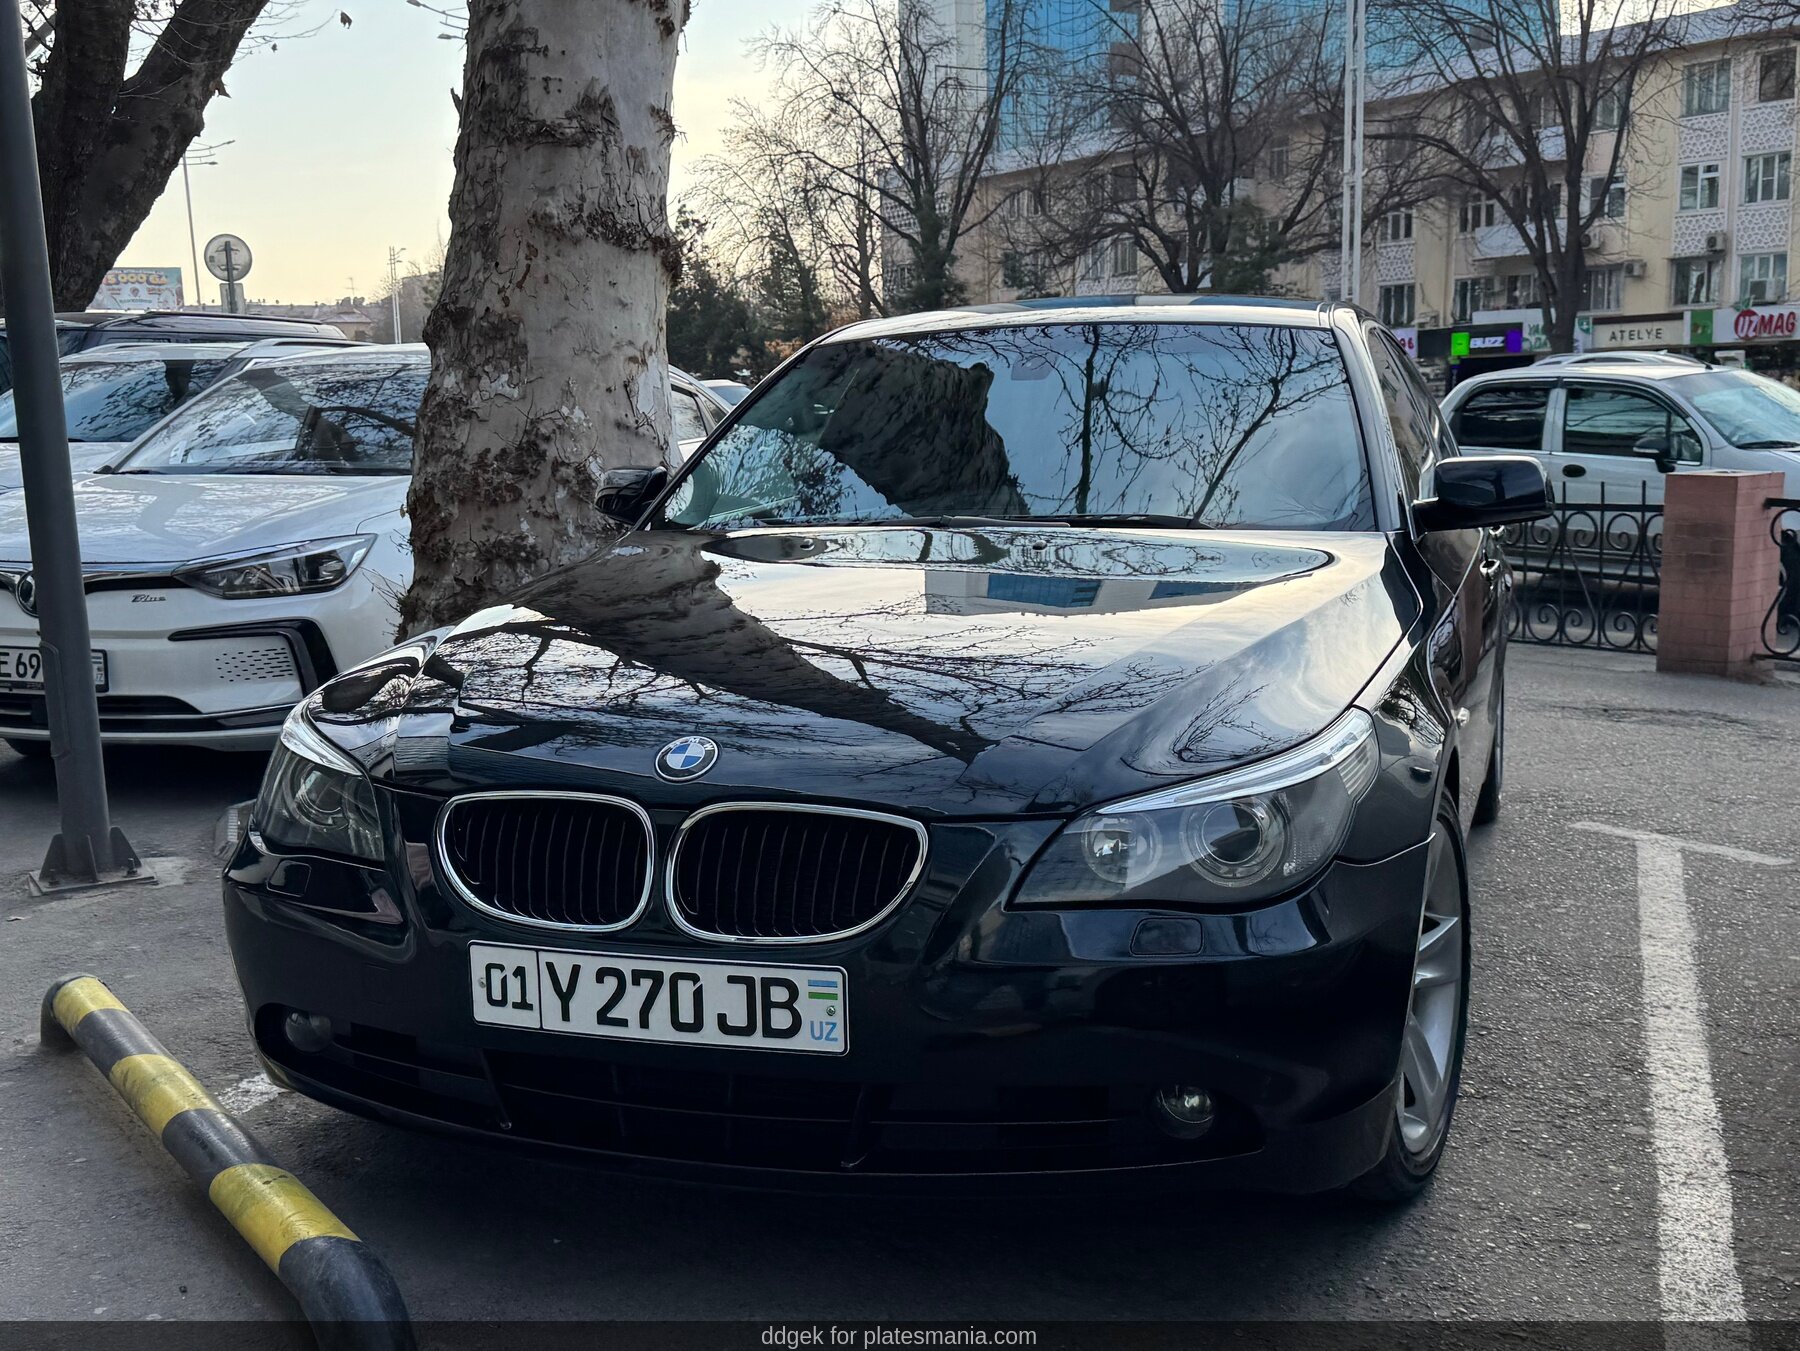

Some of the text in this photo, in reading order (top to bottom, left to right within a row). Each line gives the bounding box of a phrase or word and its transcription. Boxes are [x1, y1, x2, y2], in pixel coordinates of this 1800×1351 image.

[1609, 328, 1663, 342] ATELYE
[484, 961, 803, 1040] 01 Y 270 JB
[809, 1020, 839, 1043] UZ
